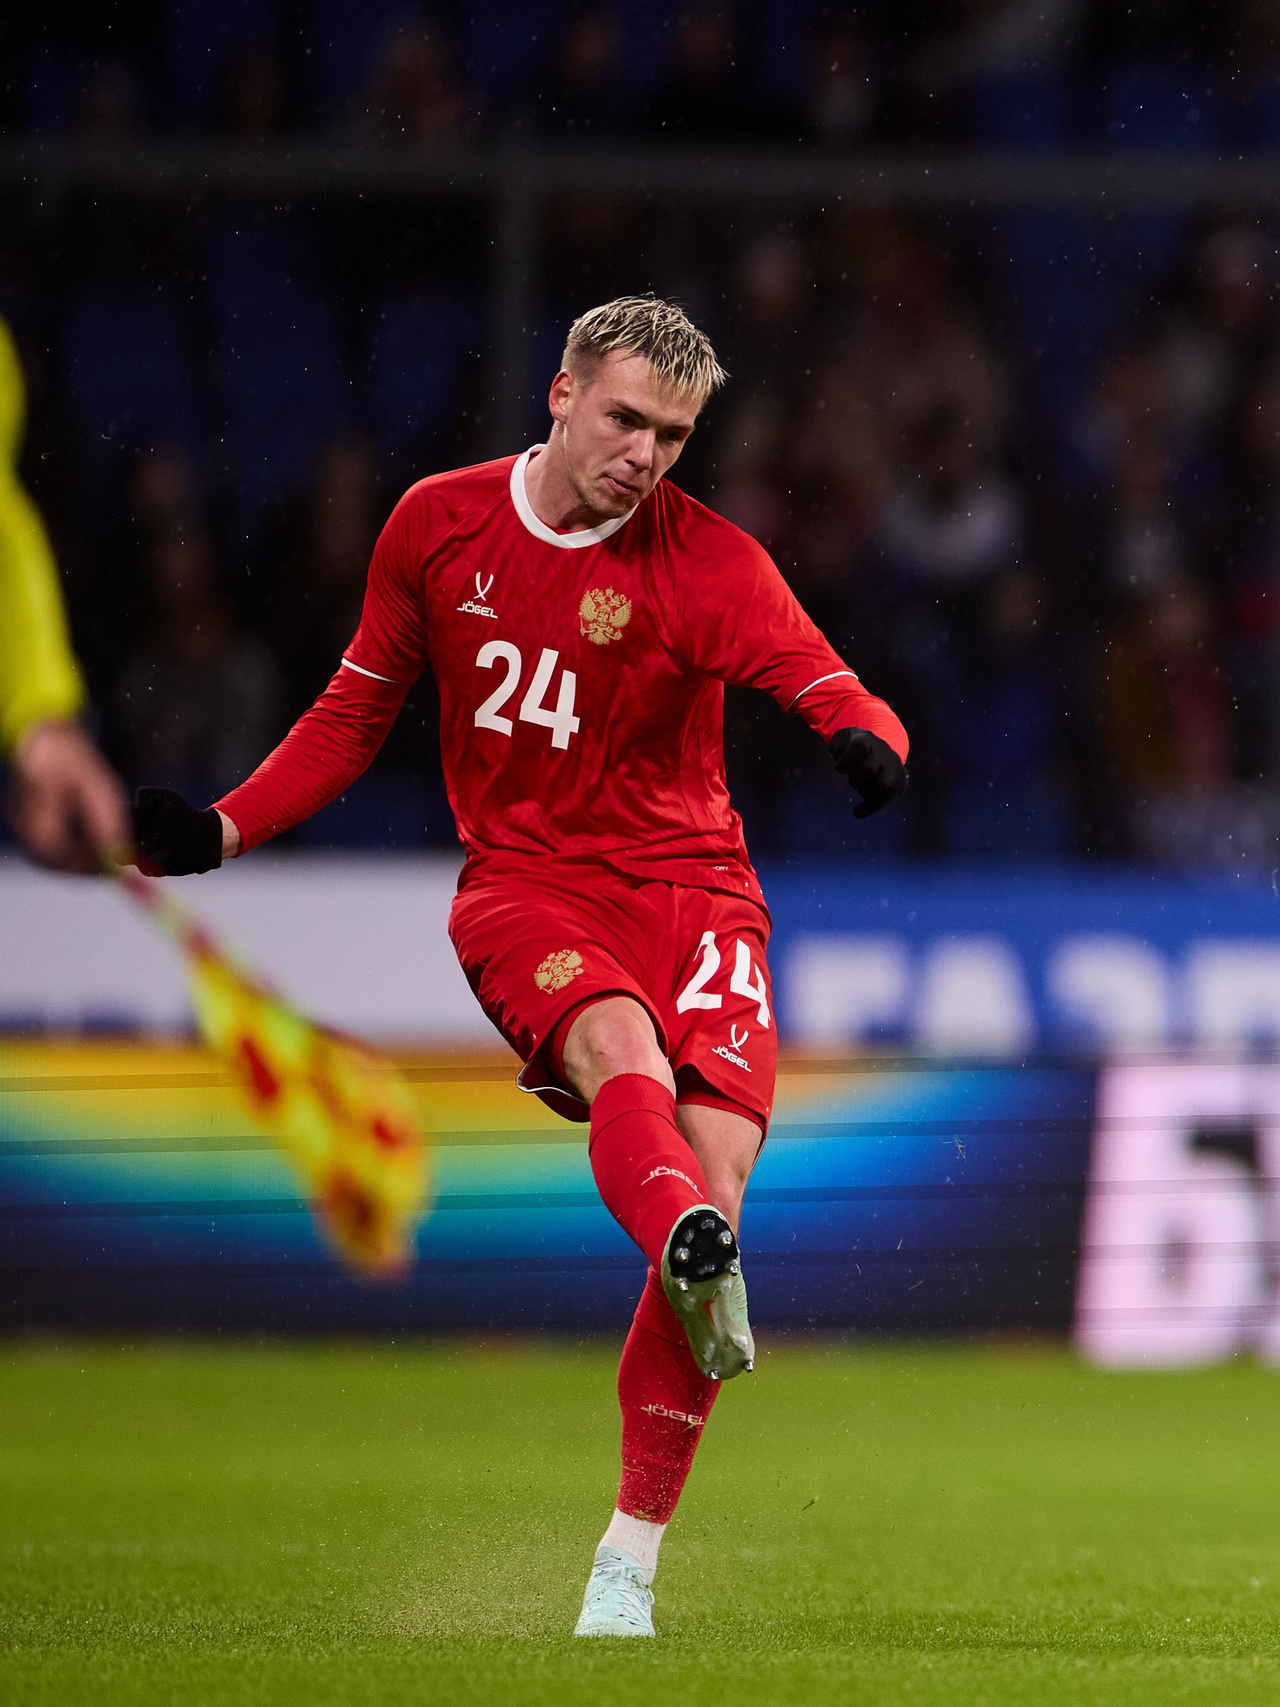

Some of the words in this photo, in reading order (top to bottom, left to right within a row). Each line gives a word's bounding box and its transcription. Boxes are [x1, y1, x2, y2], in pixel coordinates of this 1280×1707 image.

[456, 601, 499, 619] JÖGEL
[474, 640, 580, 750] 24
[676, 931, 772, 1029] 24
[711, 1045, 752, 1073] JÖGEL
[641, 1165, 704, 1200] JÖGEL
